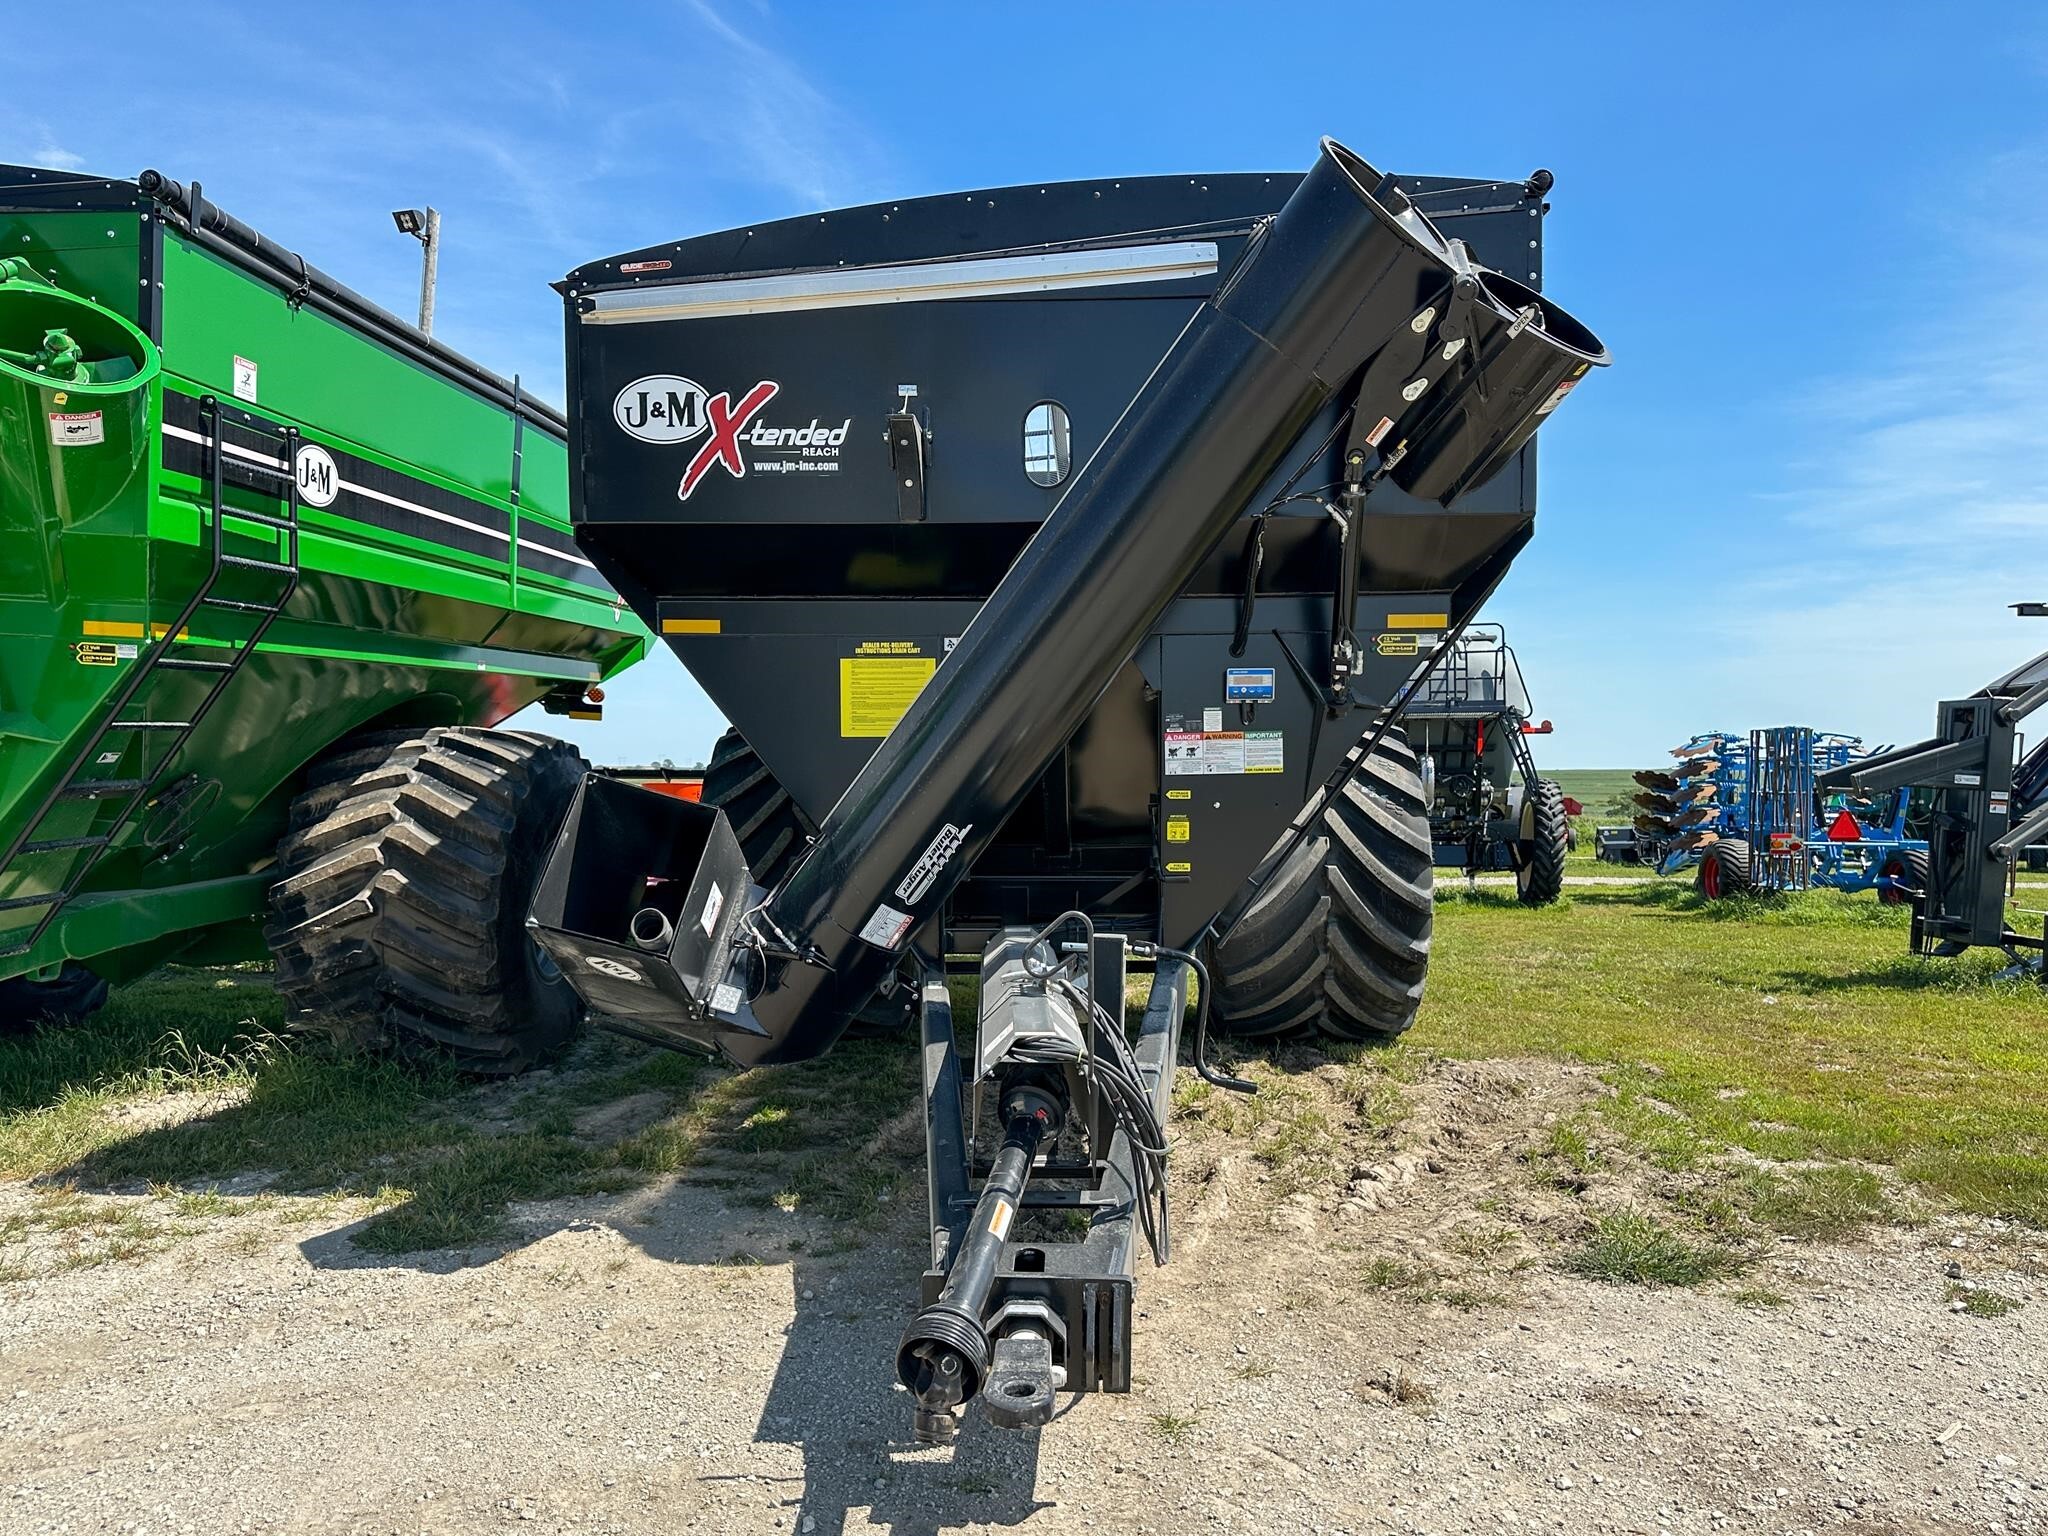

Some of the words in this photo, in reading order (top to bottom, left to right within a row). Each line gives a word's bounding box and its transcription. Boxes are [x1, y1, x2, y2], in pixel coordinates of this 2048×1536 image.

[1513, 314, 1530, 332] OPEN
[624, 391, 698, 428] J&M
[753, 460, 839, 473] www.jm-inc.com
[803, 447, 839, 457] REACH
[299, 458, 331, 496] J&M
[926, 828, 954, 861] Bullet
[902, 861, 928, 895] Auger
